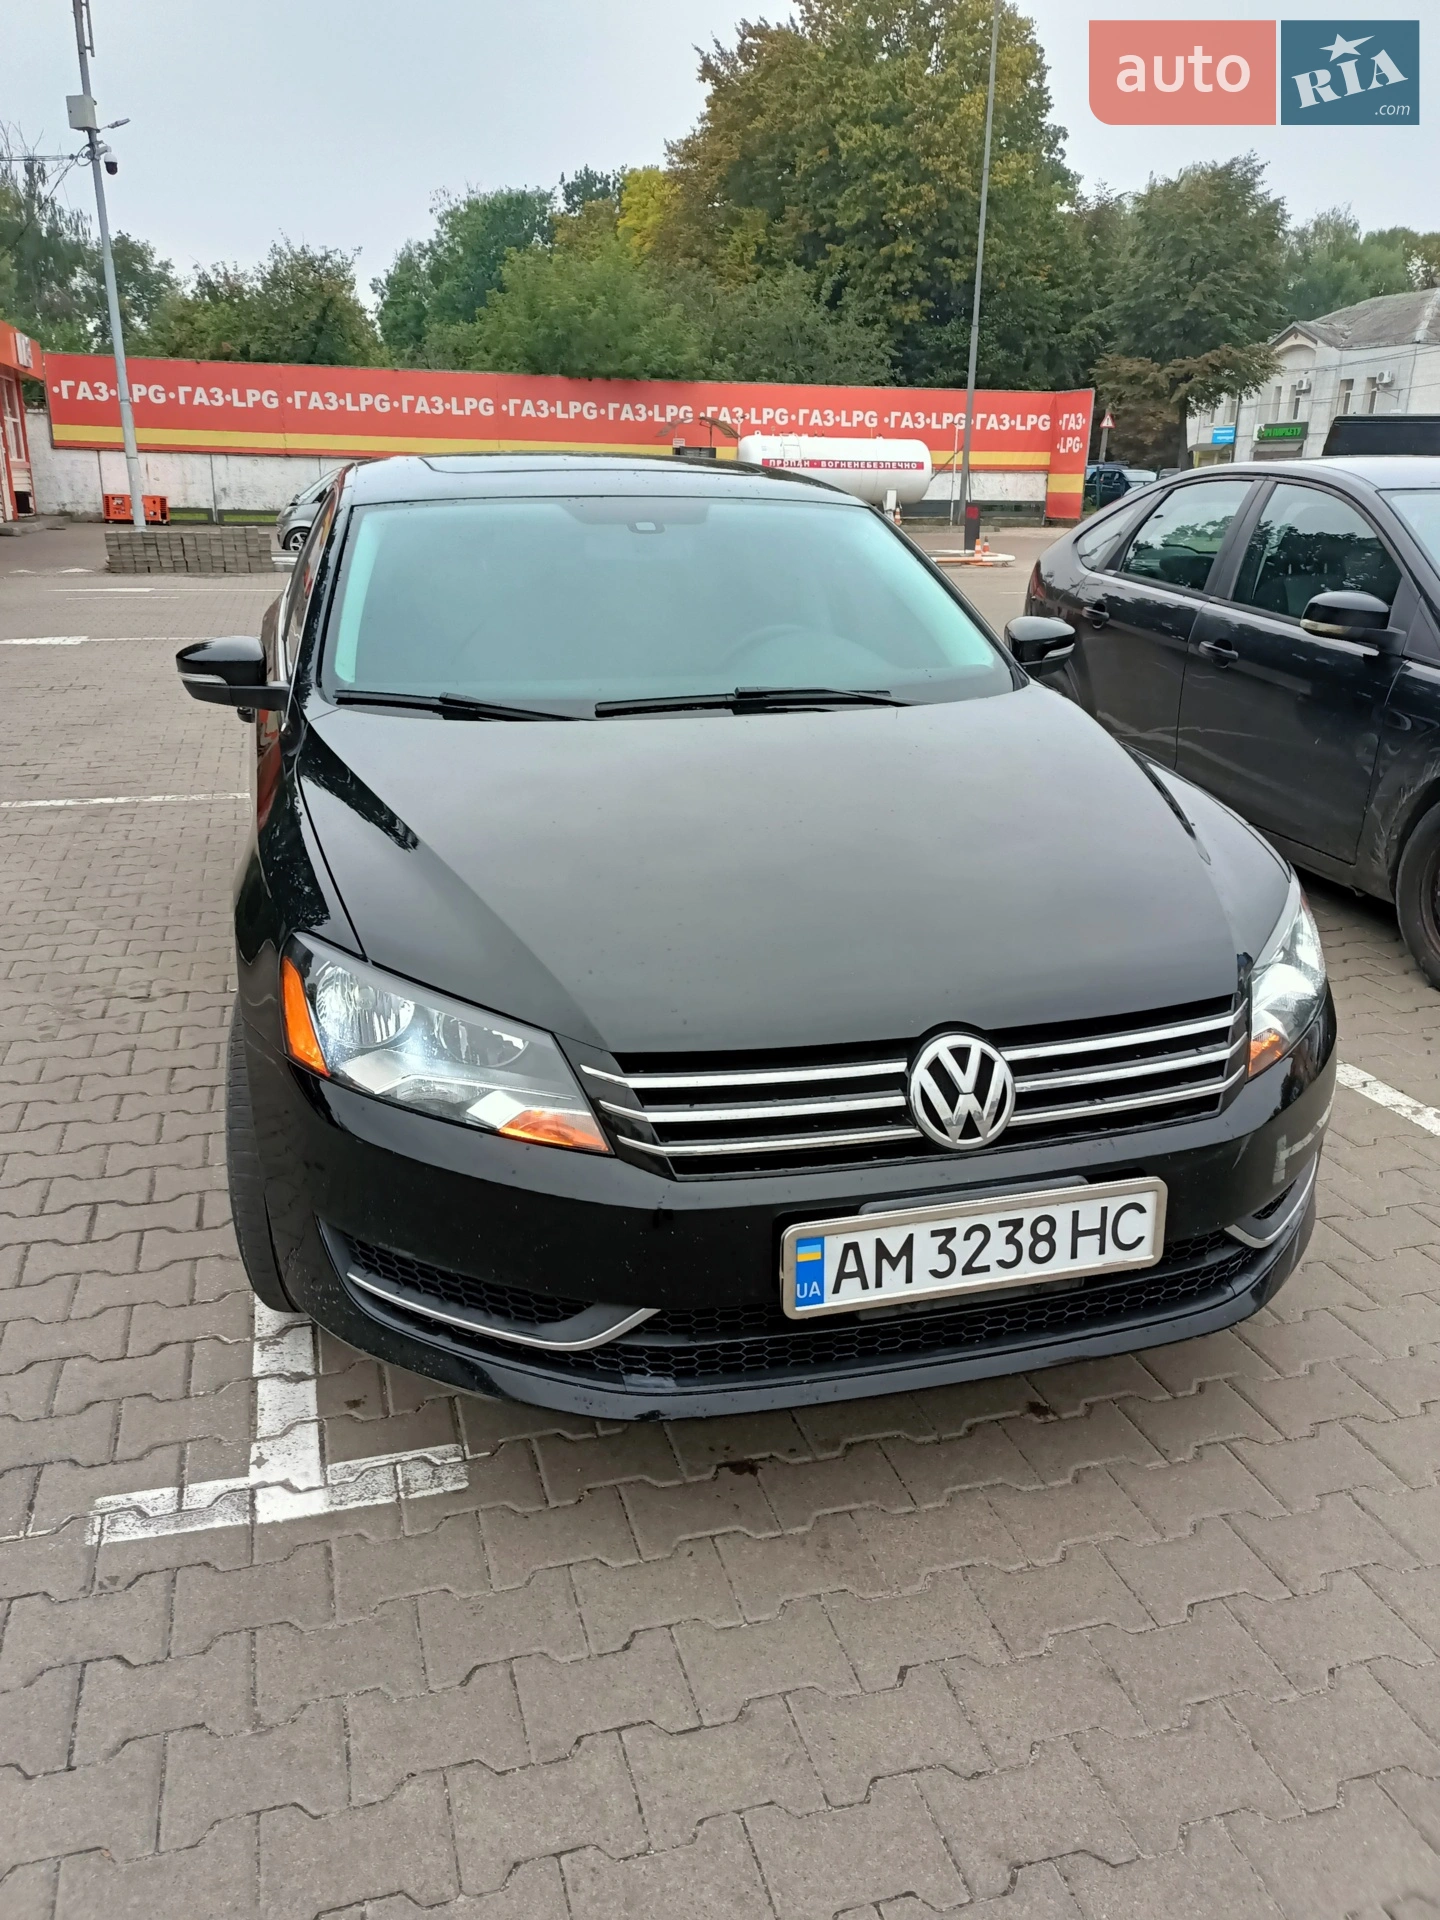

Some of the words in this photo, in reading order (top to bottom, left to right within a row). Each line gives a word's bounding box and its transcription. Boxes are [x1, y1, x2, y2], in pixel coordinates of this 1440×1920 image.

[60, 380, 109, 401] ГАЗ
[117, 382, 166, 404] PG
[178, 386, 225, 407] ГАЗ
[231, 388, 279, 409] LPG
[294, 391, 339, 411] ГАЗ
[345, 392, 391, 413] LPG
[402, 395, 444, 415] ГАЗ
[451, 397, 494, 416] LPG
[508, 398, 550, 418] ГАЗ
[556, 400, 597, 420] LPG
[608, 402, 647, 422] ГАЗ
[653, 404, 693, 424] LPG
[750, 407, 788, 426] LPG
[798, 409, 834, 427] ГАЗ
[841, 410, 878, 428] LPG
[890, 411, 925, 429] ГАЗ
[931, 412, 966, 430] LPG
[976, 413, 1010, 431] ГАЗ
[1015, 414, 1051, 431] LPG
[1062, 412, 1083, 430] ГАЗ
[1059, 436, 1081, 453] LPG
[769, 459, 810, 468] ПРОПАН
[820, 460, 918, 470] ВОГНЕНЕБЕЗПЕЧНО
[928, 1214, 1057, 1279] 3238
[796, 1281, 822, 1299] UA
